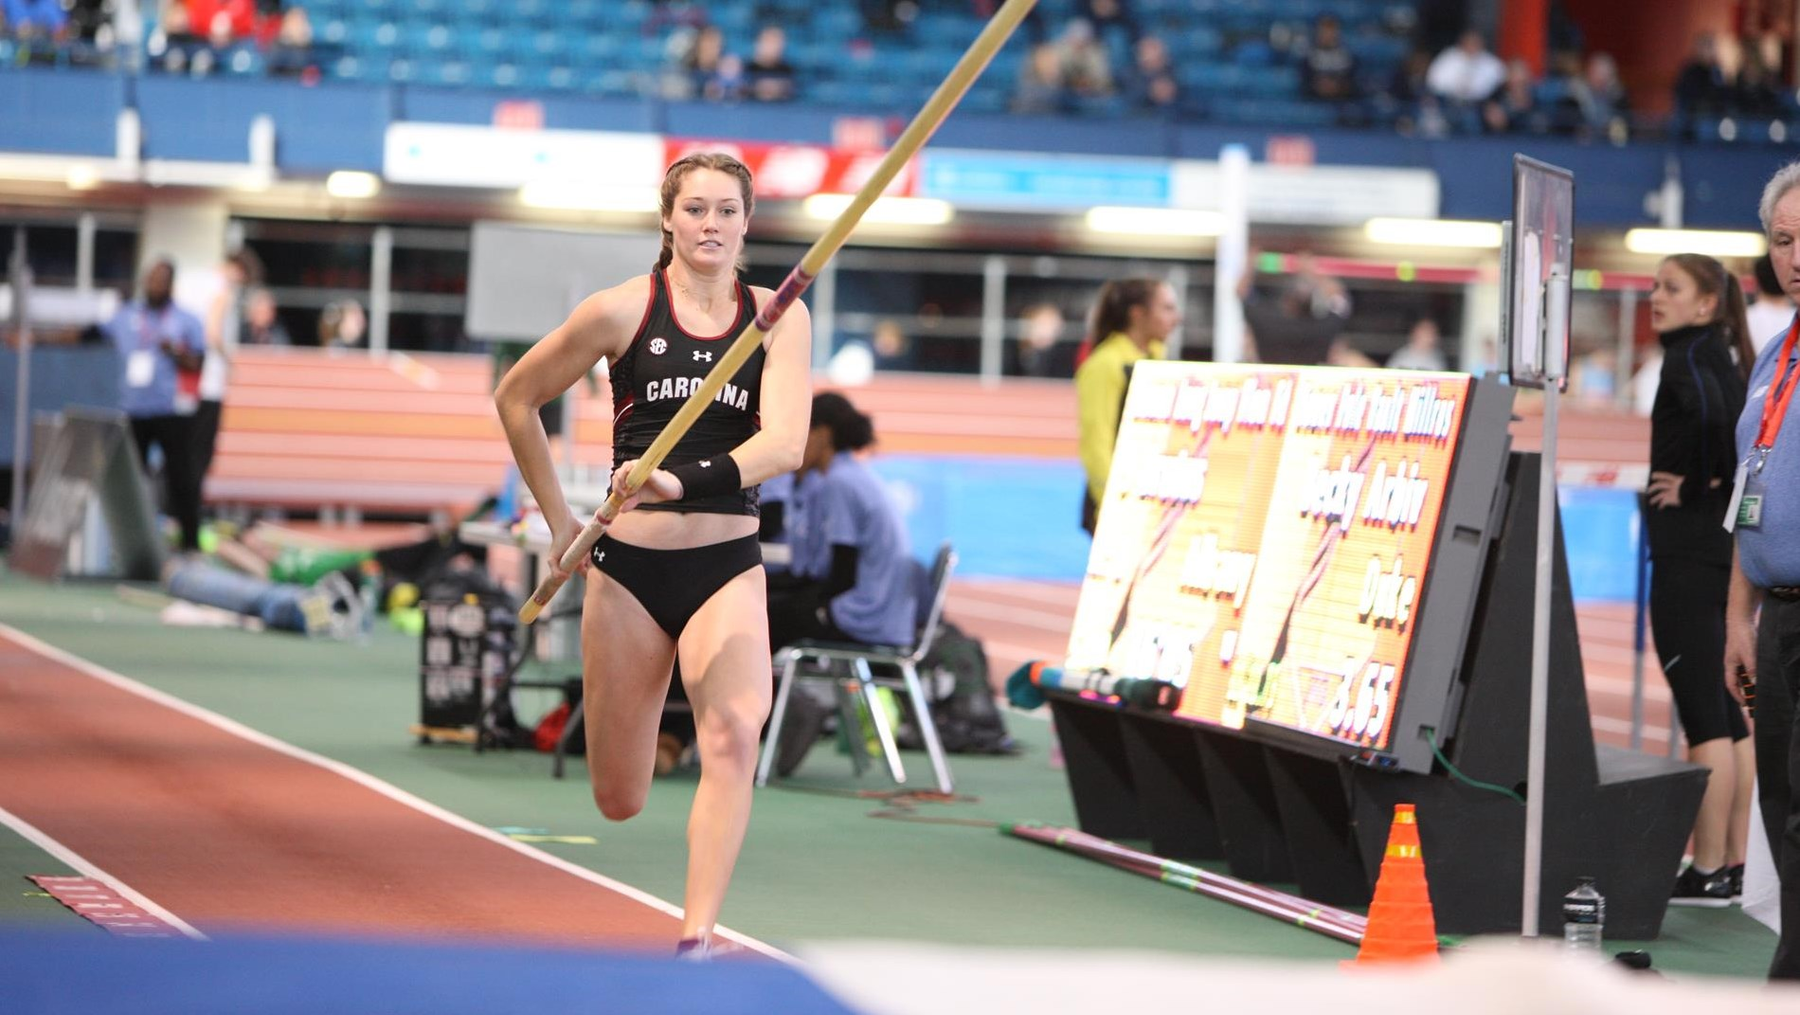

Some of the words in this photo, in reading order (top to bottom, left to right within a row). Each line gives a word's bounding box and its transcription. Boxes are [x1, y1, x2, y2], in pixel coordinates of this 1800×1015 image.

[649, 337, 668, 355] SEC
[646, 376, 749, 411] CAROINA
[1329, 657, 1395, 738] 3.65
